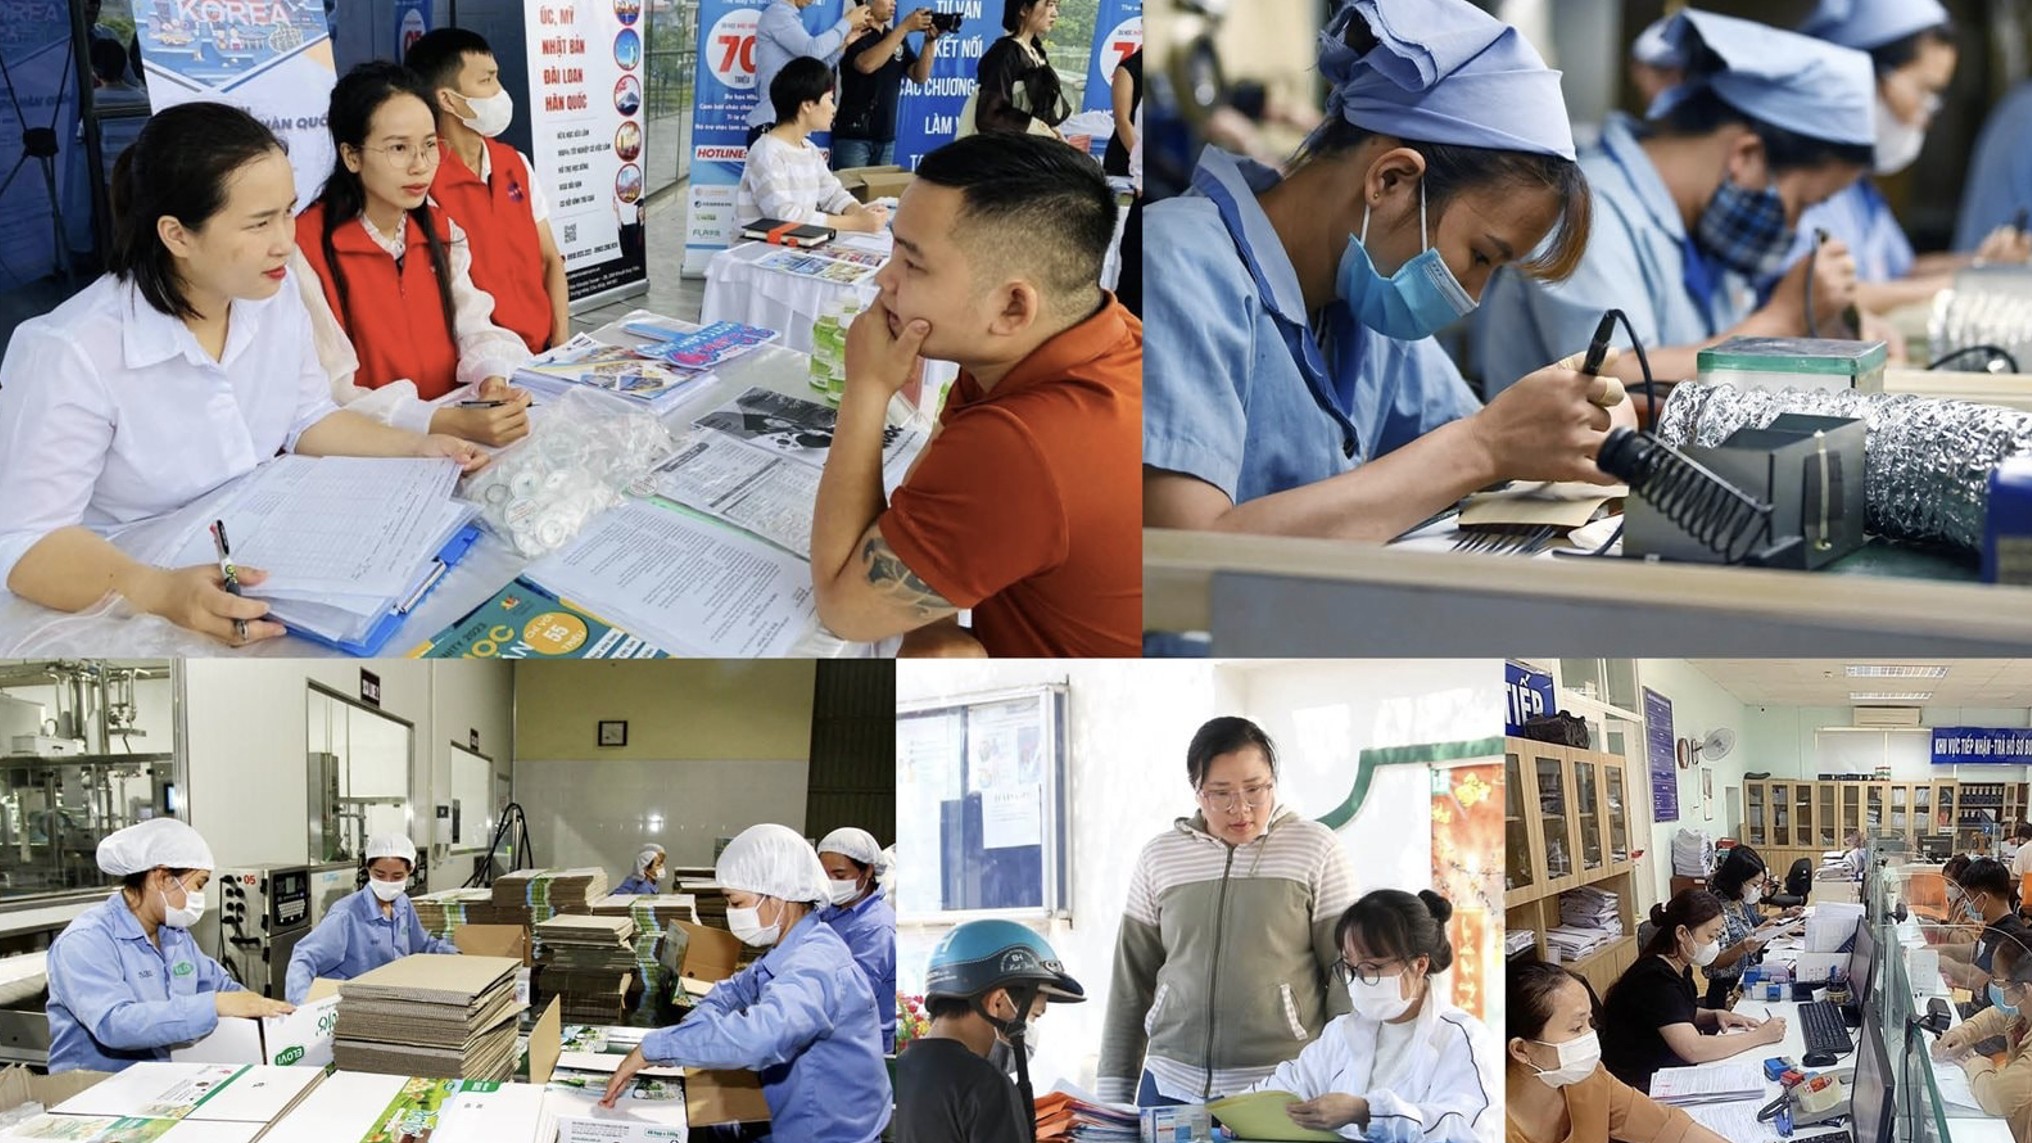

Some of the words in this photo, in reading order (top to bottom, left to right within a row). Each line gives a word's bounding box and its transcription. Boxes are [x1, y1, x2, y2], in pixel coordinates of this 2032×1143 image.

[176, 0, 292, 26] KOREA
[542, 36, 567, 57] NHẬT
[934, 34, 959, 58] KẾT
[961, 34, 983, 58] NỐI
[563, 68, 583, 84] LOAN
[545, 93, 564, 111] HÀN
[296, 112, 328, 131] QUỐ
[925, 112, 952, 134] LÀM
[697, 148, 748, 160] HOTLINE:
[542, 624, 569, 643] 55
[1505, 674, 1544, 726] TIẾP
[243, 874, 256, 885] 05
[277, 1046, 303, 1065] ELOVI
